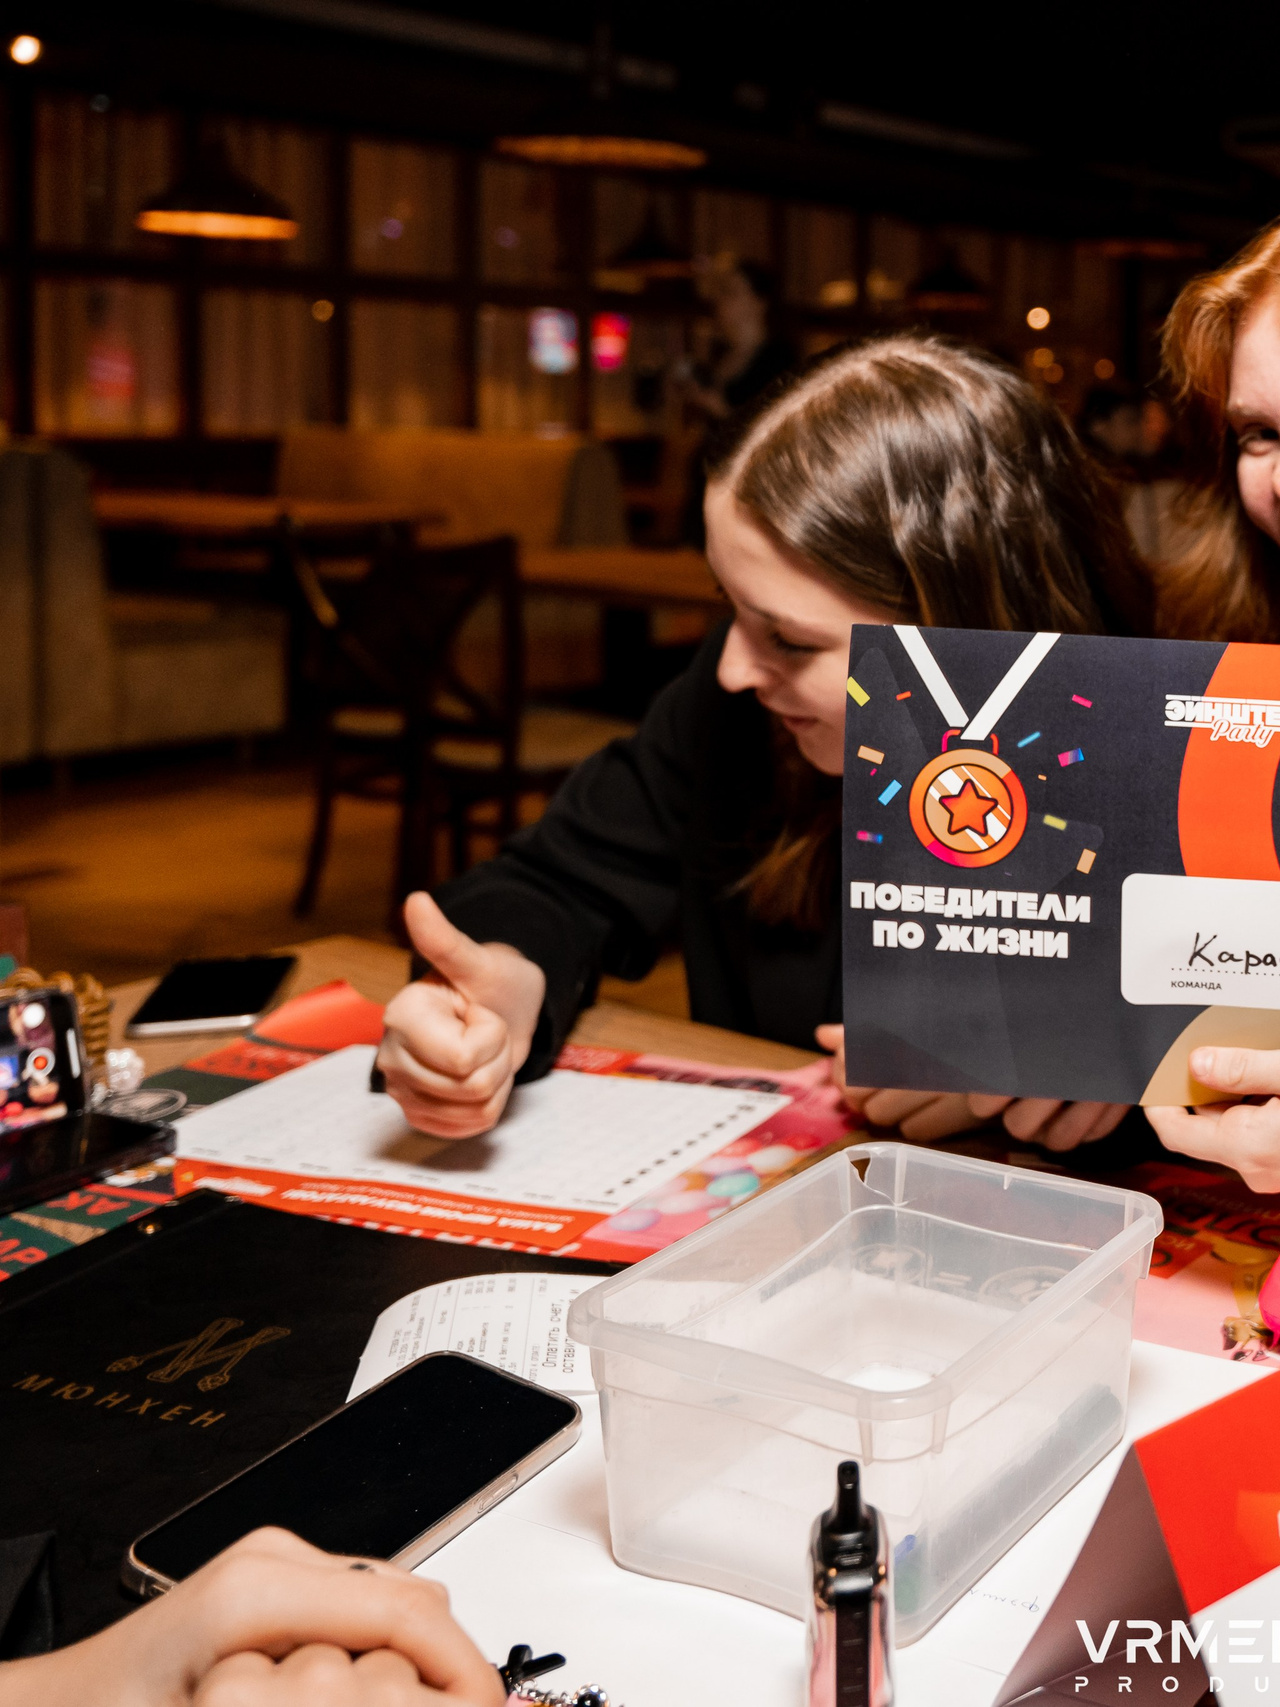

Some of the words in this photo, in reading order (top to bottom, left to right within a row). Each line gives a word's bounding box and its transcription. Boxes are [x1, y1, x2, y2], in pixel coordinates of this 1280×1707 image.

[1210, 719, 1276, 748] Party
[850, 881, 1091, 923] ПОБЕДИТЕЛИ
[872, 919, 925, 949] ПО
[935, 923, 1069, 958] ЖИЗНИ
[1171, 980, 1223, 991] КОМАНДА
[541, 1326, 561, 1368] Оплатить
[561, 1336, 576, 1374] оставит
[12, 1373, 226, 1428] МЮНХЕН
